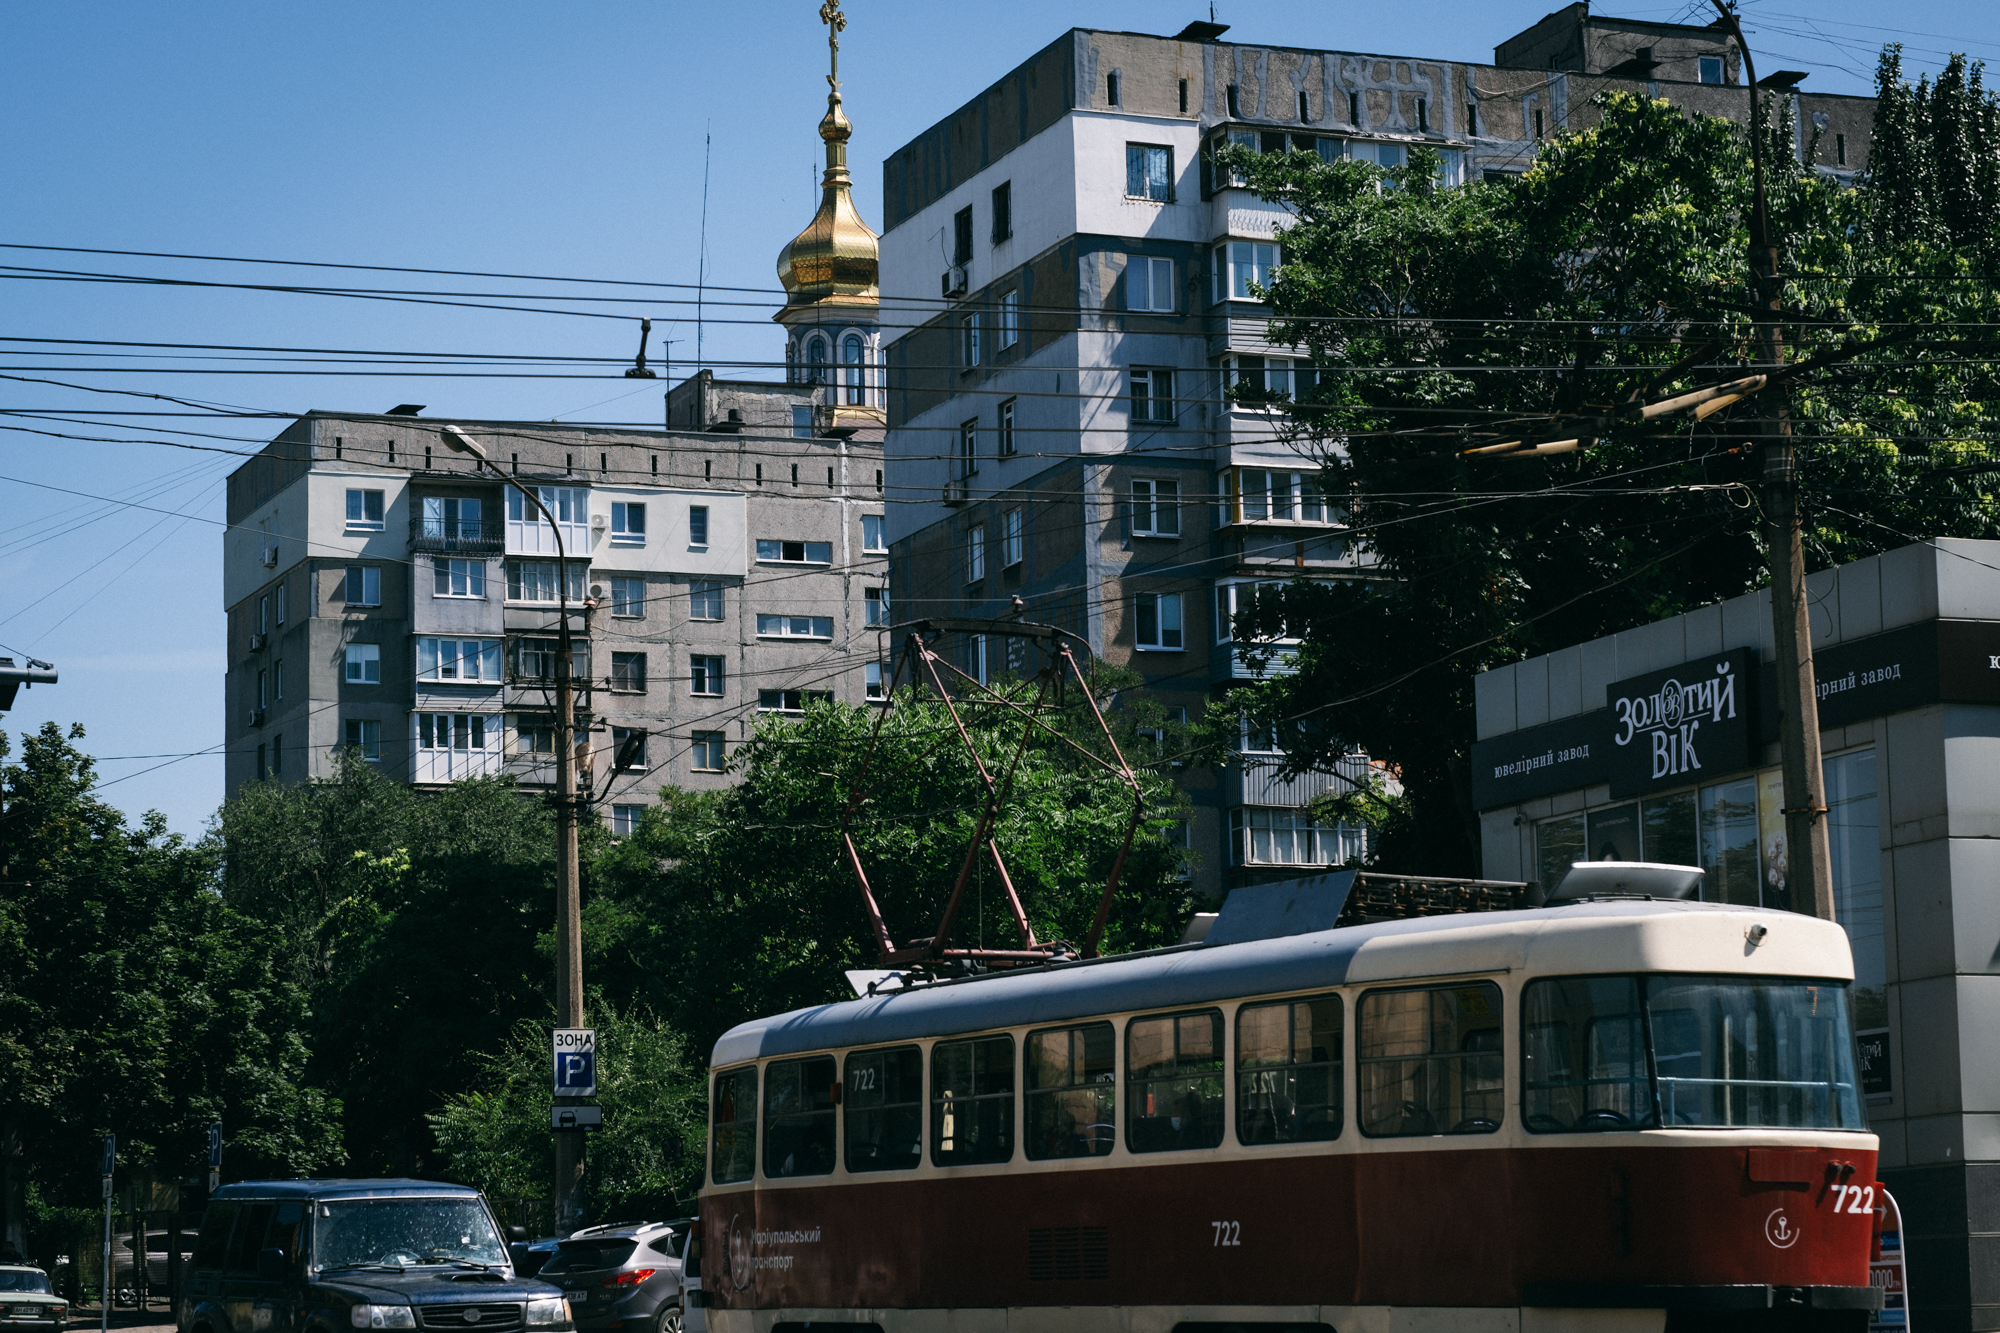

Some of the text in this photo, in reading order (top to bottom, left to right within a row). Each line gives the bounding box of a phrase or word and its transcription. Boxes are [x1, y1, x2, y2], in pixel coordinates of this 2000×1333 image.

[1816, 663, 1901, 701] ірний завод
[1493, 744, 1590, 779] ювелірний завод
[1651, 719, 1702, 780] ВІК
[555, 1033, 593, 1047] ЗОНА
[1858, 1040, 1882, 1058] ОТИЙ
[565, 1054, 586, 1086] P
[1860, 1055, 1872, 1071] ІК
[852, 1067, 875, 1092] 722
[105, 1138, 113, 1170] P
[211, 1128, 219, 1162] P
[1830, 1184, 1875, 1215] 722
[751, 1225, 822, 1248] Маріупольський
[1211, 1220, 1241, 1247] 722
